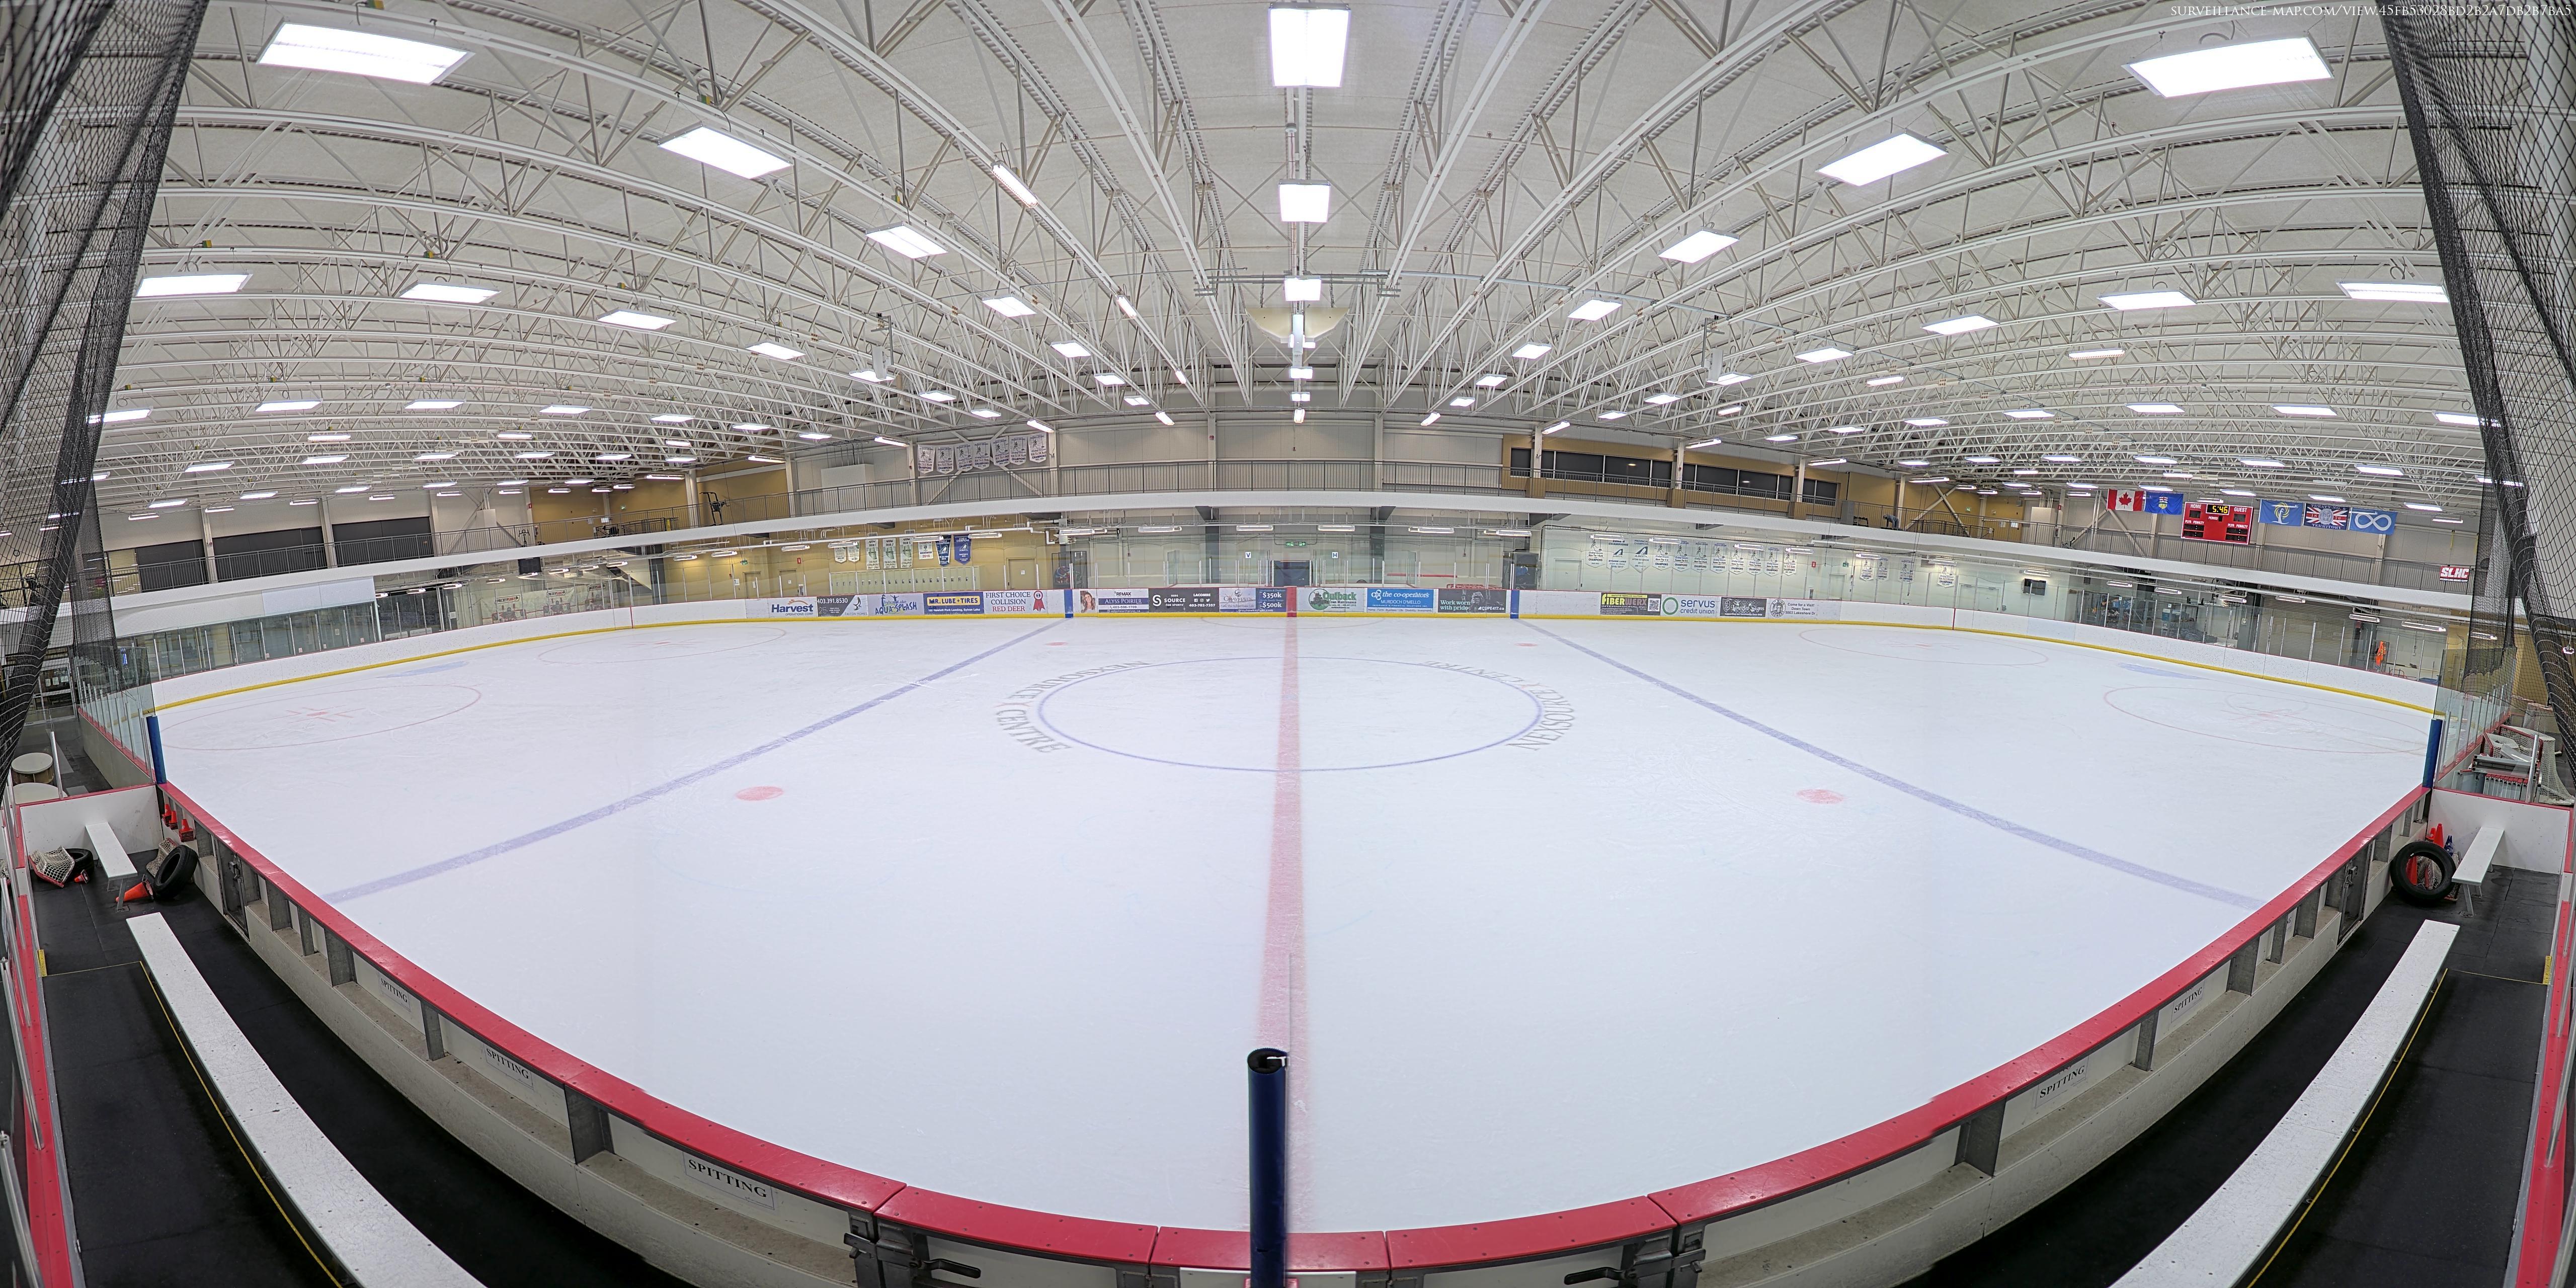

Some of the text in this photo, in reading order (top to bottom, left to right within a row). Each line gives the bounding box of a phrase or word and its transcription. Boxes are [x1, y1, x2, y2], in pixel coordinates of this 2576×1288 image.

[2212, 505, 2228, 514] 5:46
[2440, 567, 2469, 578] SLHC
[1322, 592, 1357, 600] Outback
[1680, 599, 1716, 608] servus
[771, 604, 814, 613] Harvest
[875, 605, 893, 615] AQUA
[1750, 605, 1765, 613] Signs
[1504, 689, 1575, 751] NEXSOURCE
[995, 709, 1073, 753] CENTRE
[380, 978, 408, 1004] SPITTING
[2174, 987, 2203, 1014] SPITTING
[486, 1048, 529, 1080] SPITTING
[2040, 1065, 2085, 1099] SPITTING
[688, 1159, 767, 1198] SPITTING
